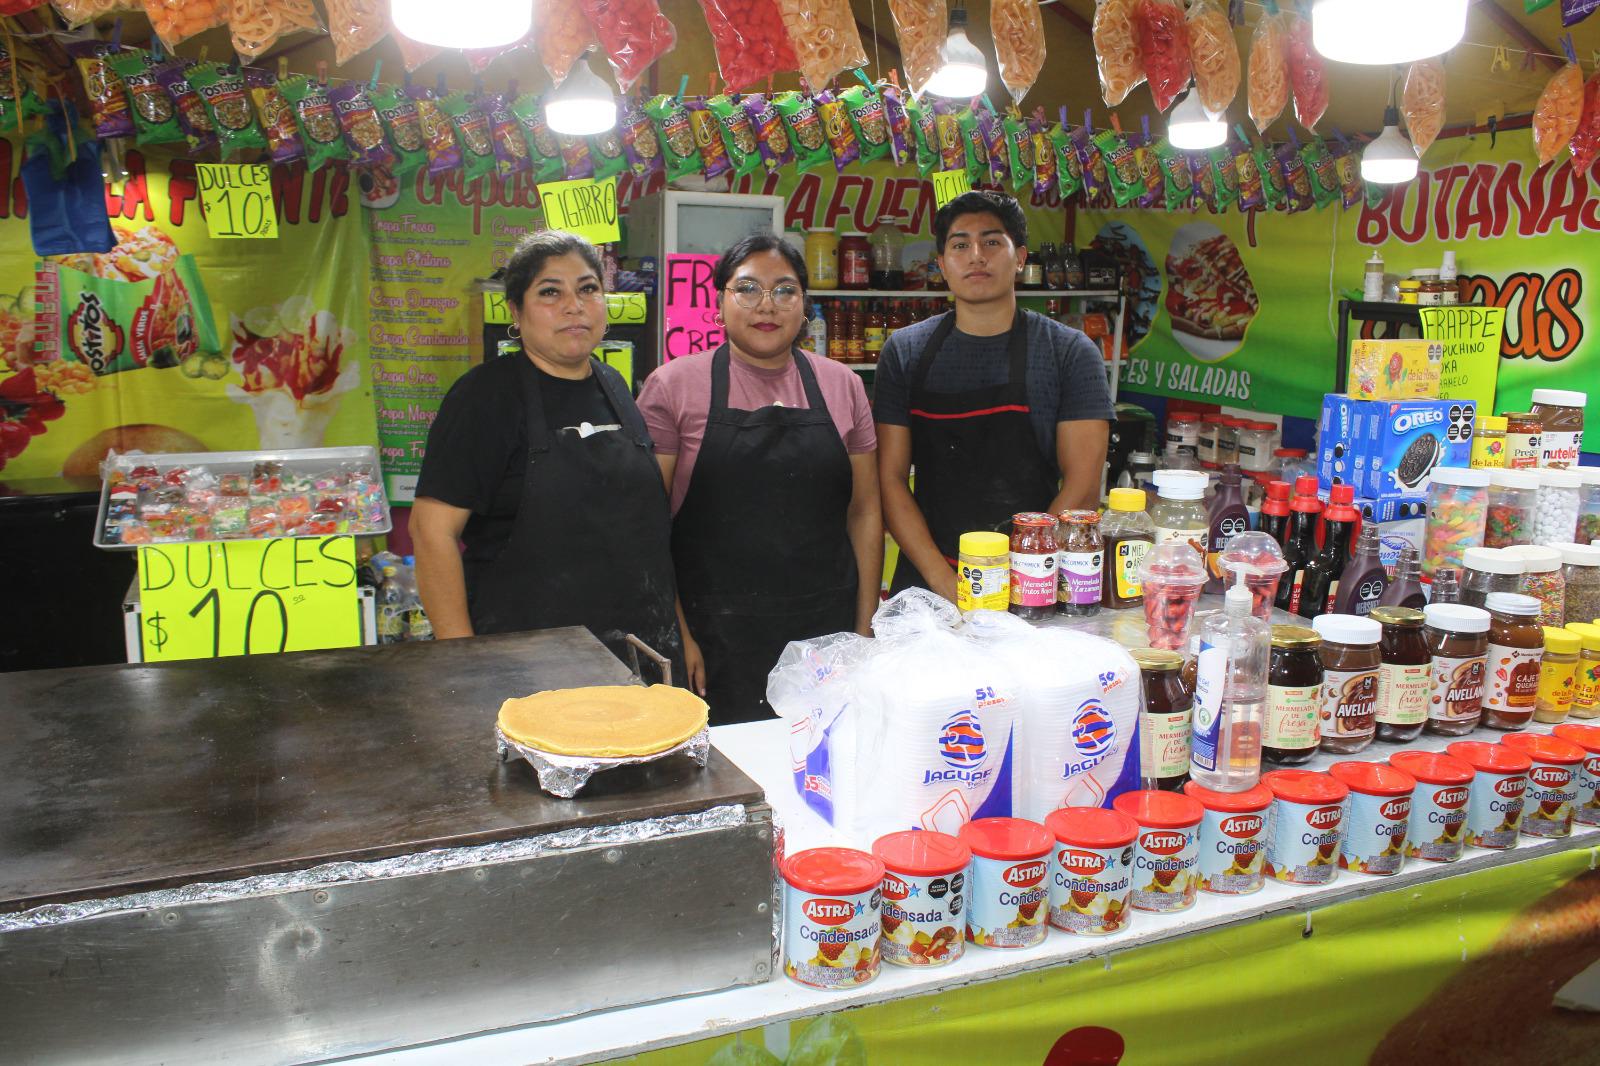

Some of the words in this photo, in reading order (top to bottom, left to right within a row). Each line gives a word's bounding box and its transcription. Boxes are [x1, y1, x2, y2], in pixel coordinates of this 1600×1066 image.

[198, 164, 270, 190] DULCES
[217, 189, 264, 236] 10
[541, 183, 617, 231] CIGARRO
[1422, 309, 1495, 340] FRAPPE
[1442, 341, 1485, 358] PUCHINO
[1155, 362, 1165, 388] Y
[1168, 363, 1251, 400] SALADAS
[1340, 403, 1349, 439] OREO
[1394, 410, 1443, 432] OREO
[1543, 446, 1578, 460] nutella
[142, 534, 356, 591] DULCES
[147, 610, 168, 653] $
[188, 587, 288, 659] 10
[1336, 701, 1377, 717] AVELLAN
[1531, 768, 1569, 782] ASTRA
[1223, 819, 1261, 833] ASTRA
[1143, 833, 1184, 850] ASTRA
[1060, 852, 1102, 870] ASTRA
[1006, 864, 1046, 883] ASTRA
[1054, 872, 1130, 893] Condensada
[882, 878, 905, 895] TRA
[806, 901, 851, 918] ASTRA
[800, 919, 879, 943] Condensada
